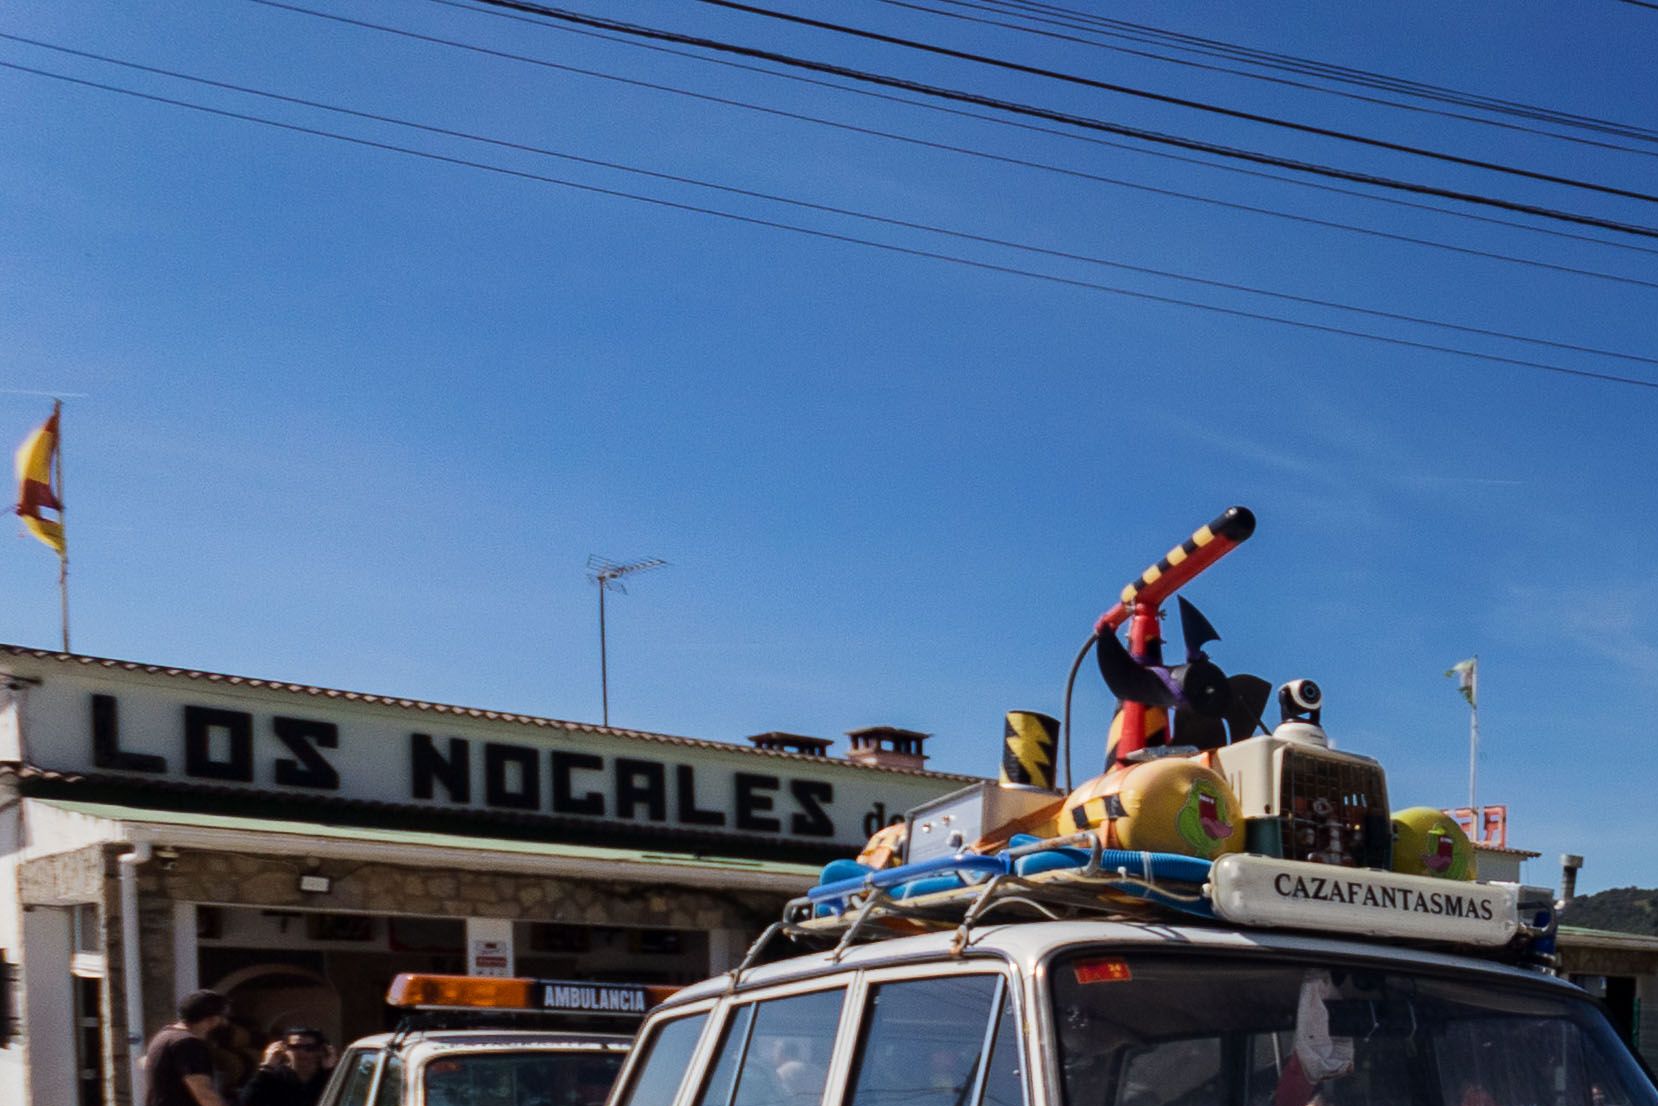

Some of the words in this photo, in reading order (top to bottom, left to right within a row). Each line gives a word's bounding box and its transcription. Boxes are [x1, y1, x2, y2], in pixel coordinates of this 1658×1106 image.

[92, 692, 340, 790] LOS
[411, 732, 834, 838] NOGALES
[1274, 872, 1494, 921] CAZAFANTASMAS
[544, 985, 645, 1012] AMBULANCIA
